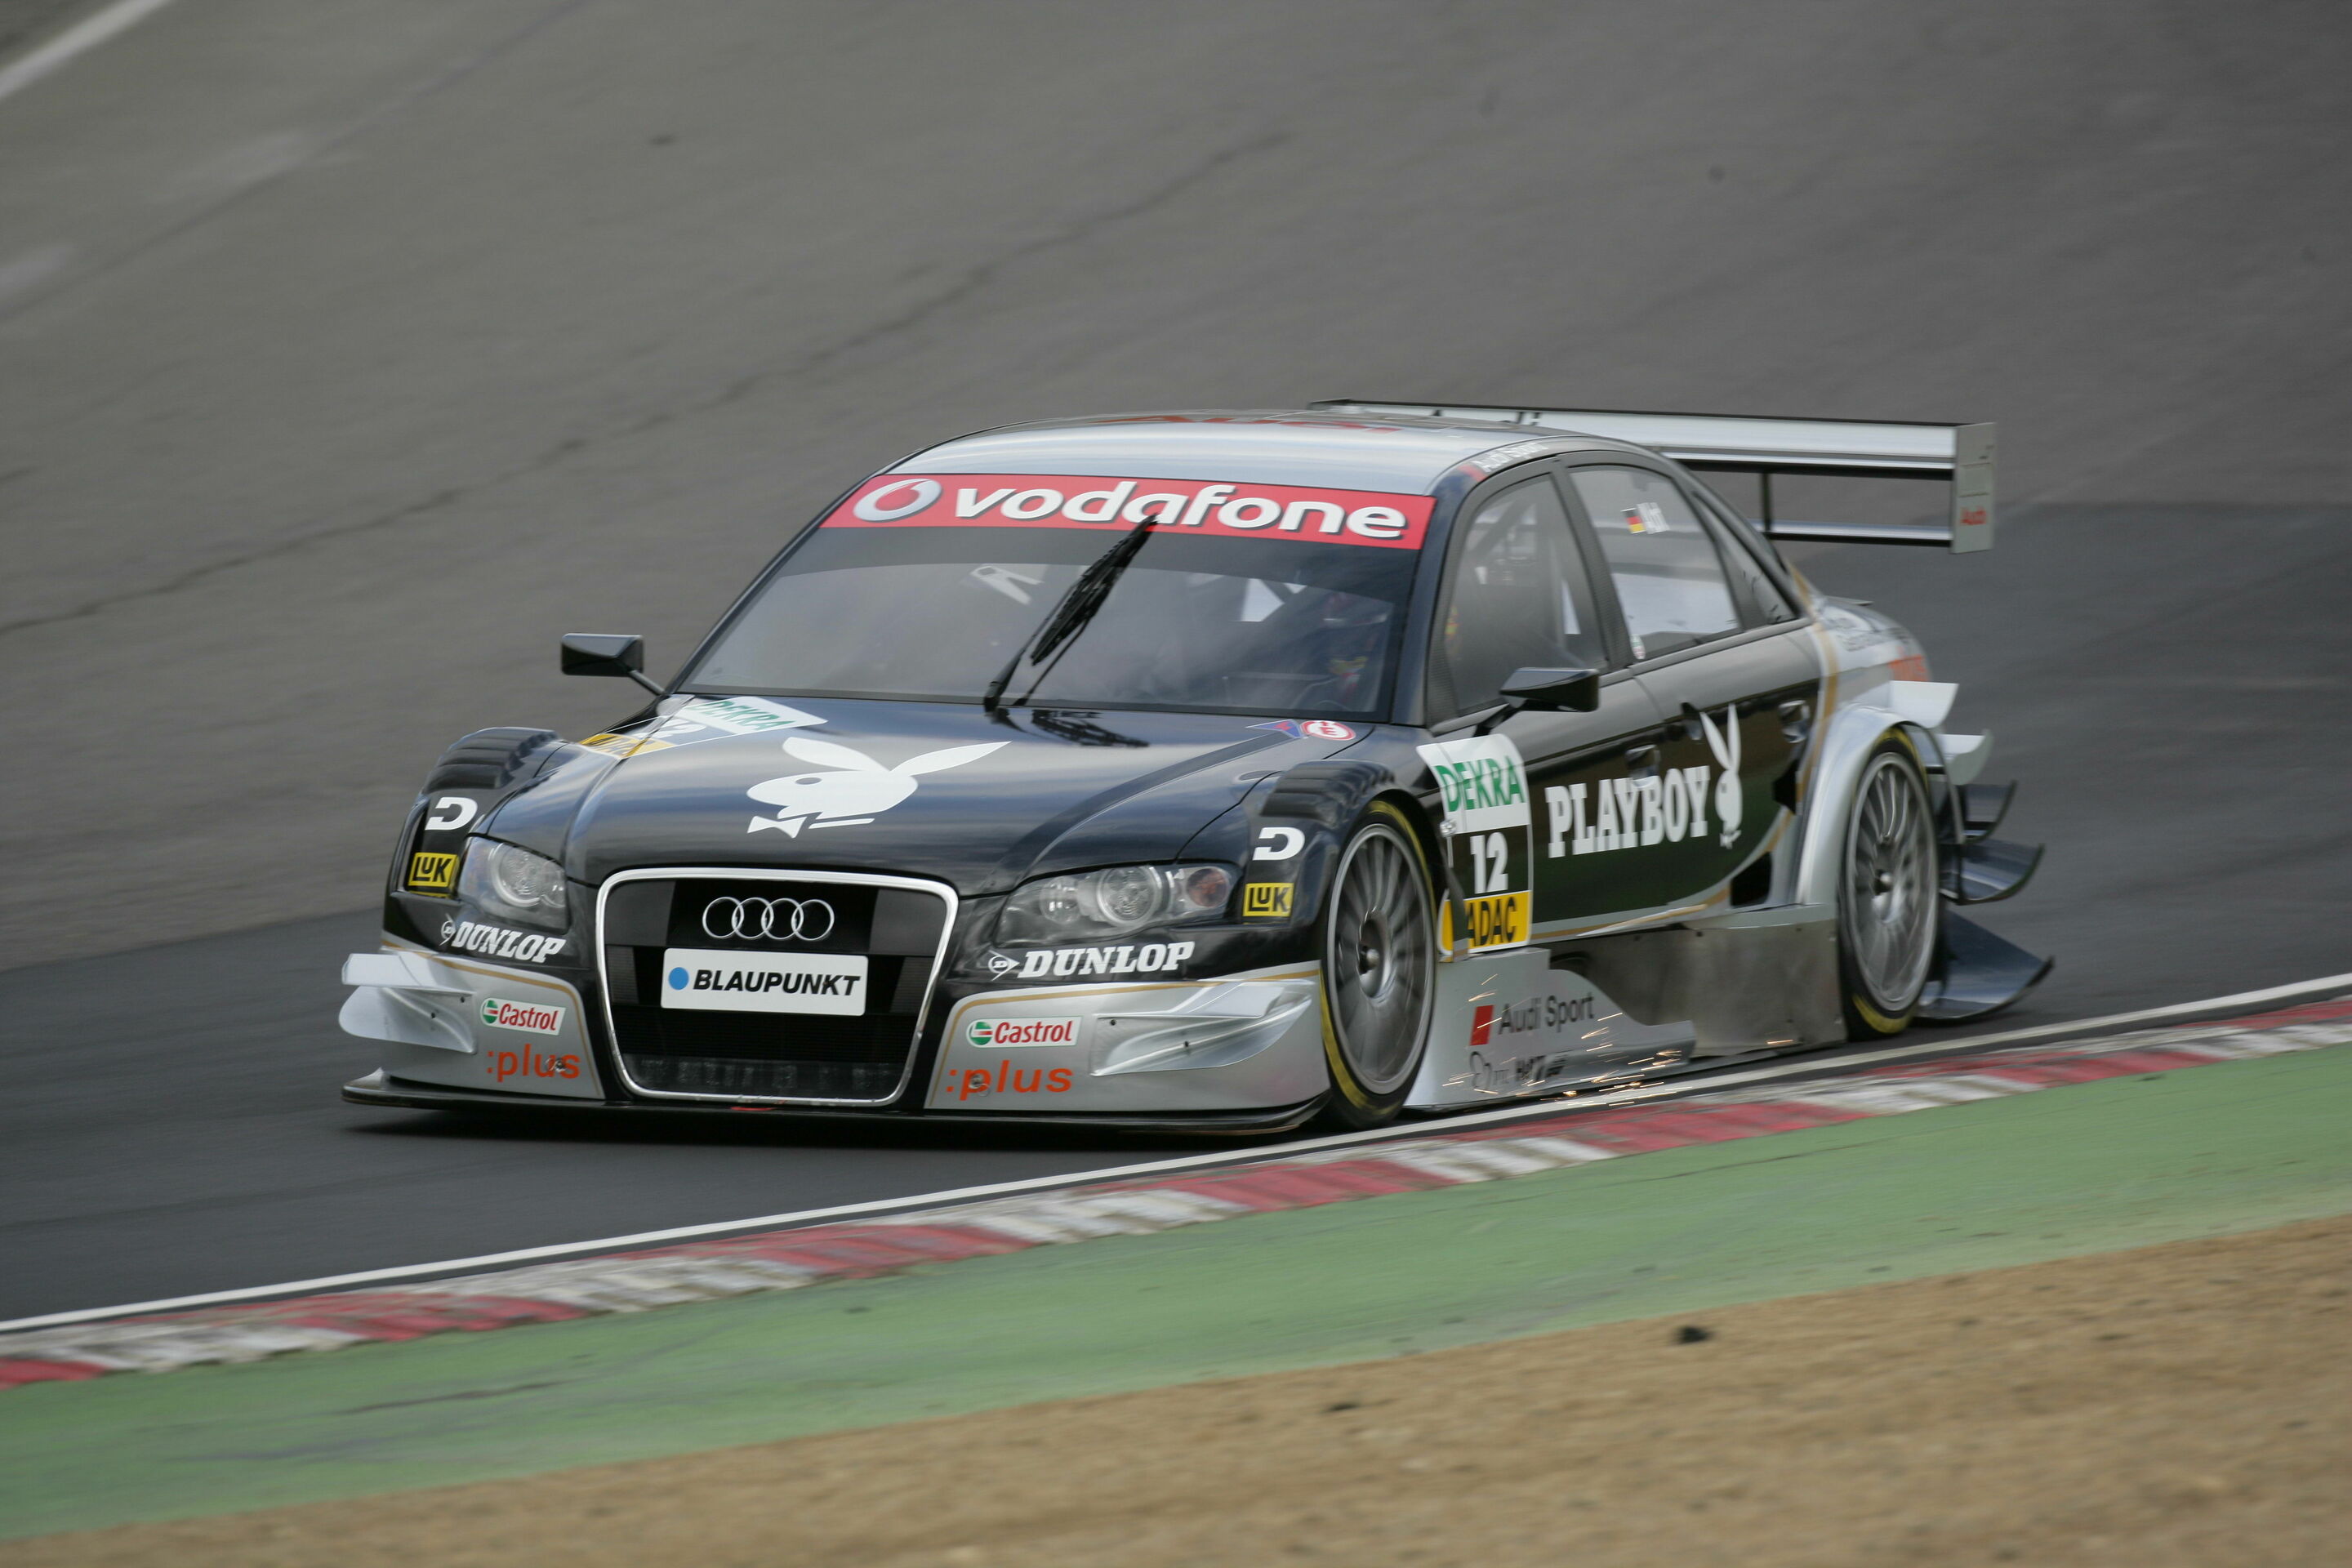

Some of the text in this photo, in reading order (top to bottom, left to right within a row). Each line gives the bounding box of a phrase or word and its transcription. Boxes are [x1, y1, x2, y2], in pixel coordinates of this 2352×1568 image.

[956, 480, 1407, 539] vodafone
[1434, 755, 1526, 812] DEKRA
[1544, 765, 1711, 858] PLAYBOY
[1470, 831, 1509, 894] 12
[452, 921, 567, 964] DUNLOP
[1467, 896, 1517, 947] ADAC
[1017, 941, 1195, 978] DUNLOP
[693, 969, 862, 996] BLAUPUNKT
[498, 1003, 559, 1031] Castrol
[994, 1020, 1073, 1045] Castrol
[1498, 992, 1594, 1035] Audi Sport
